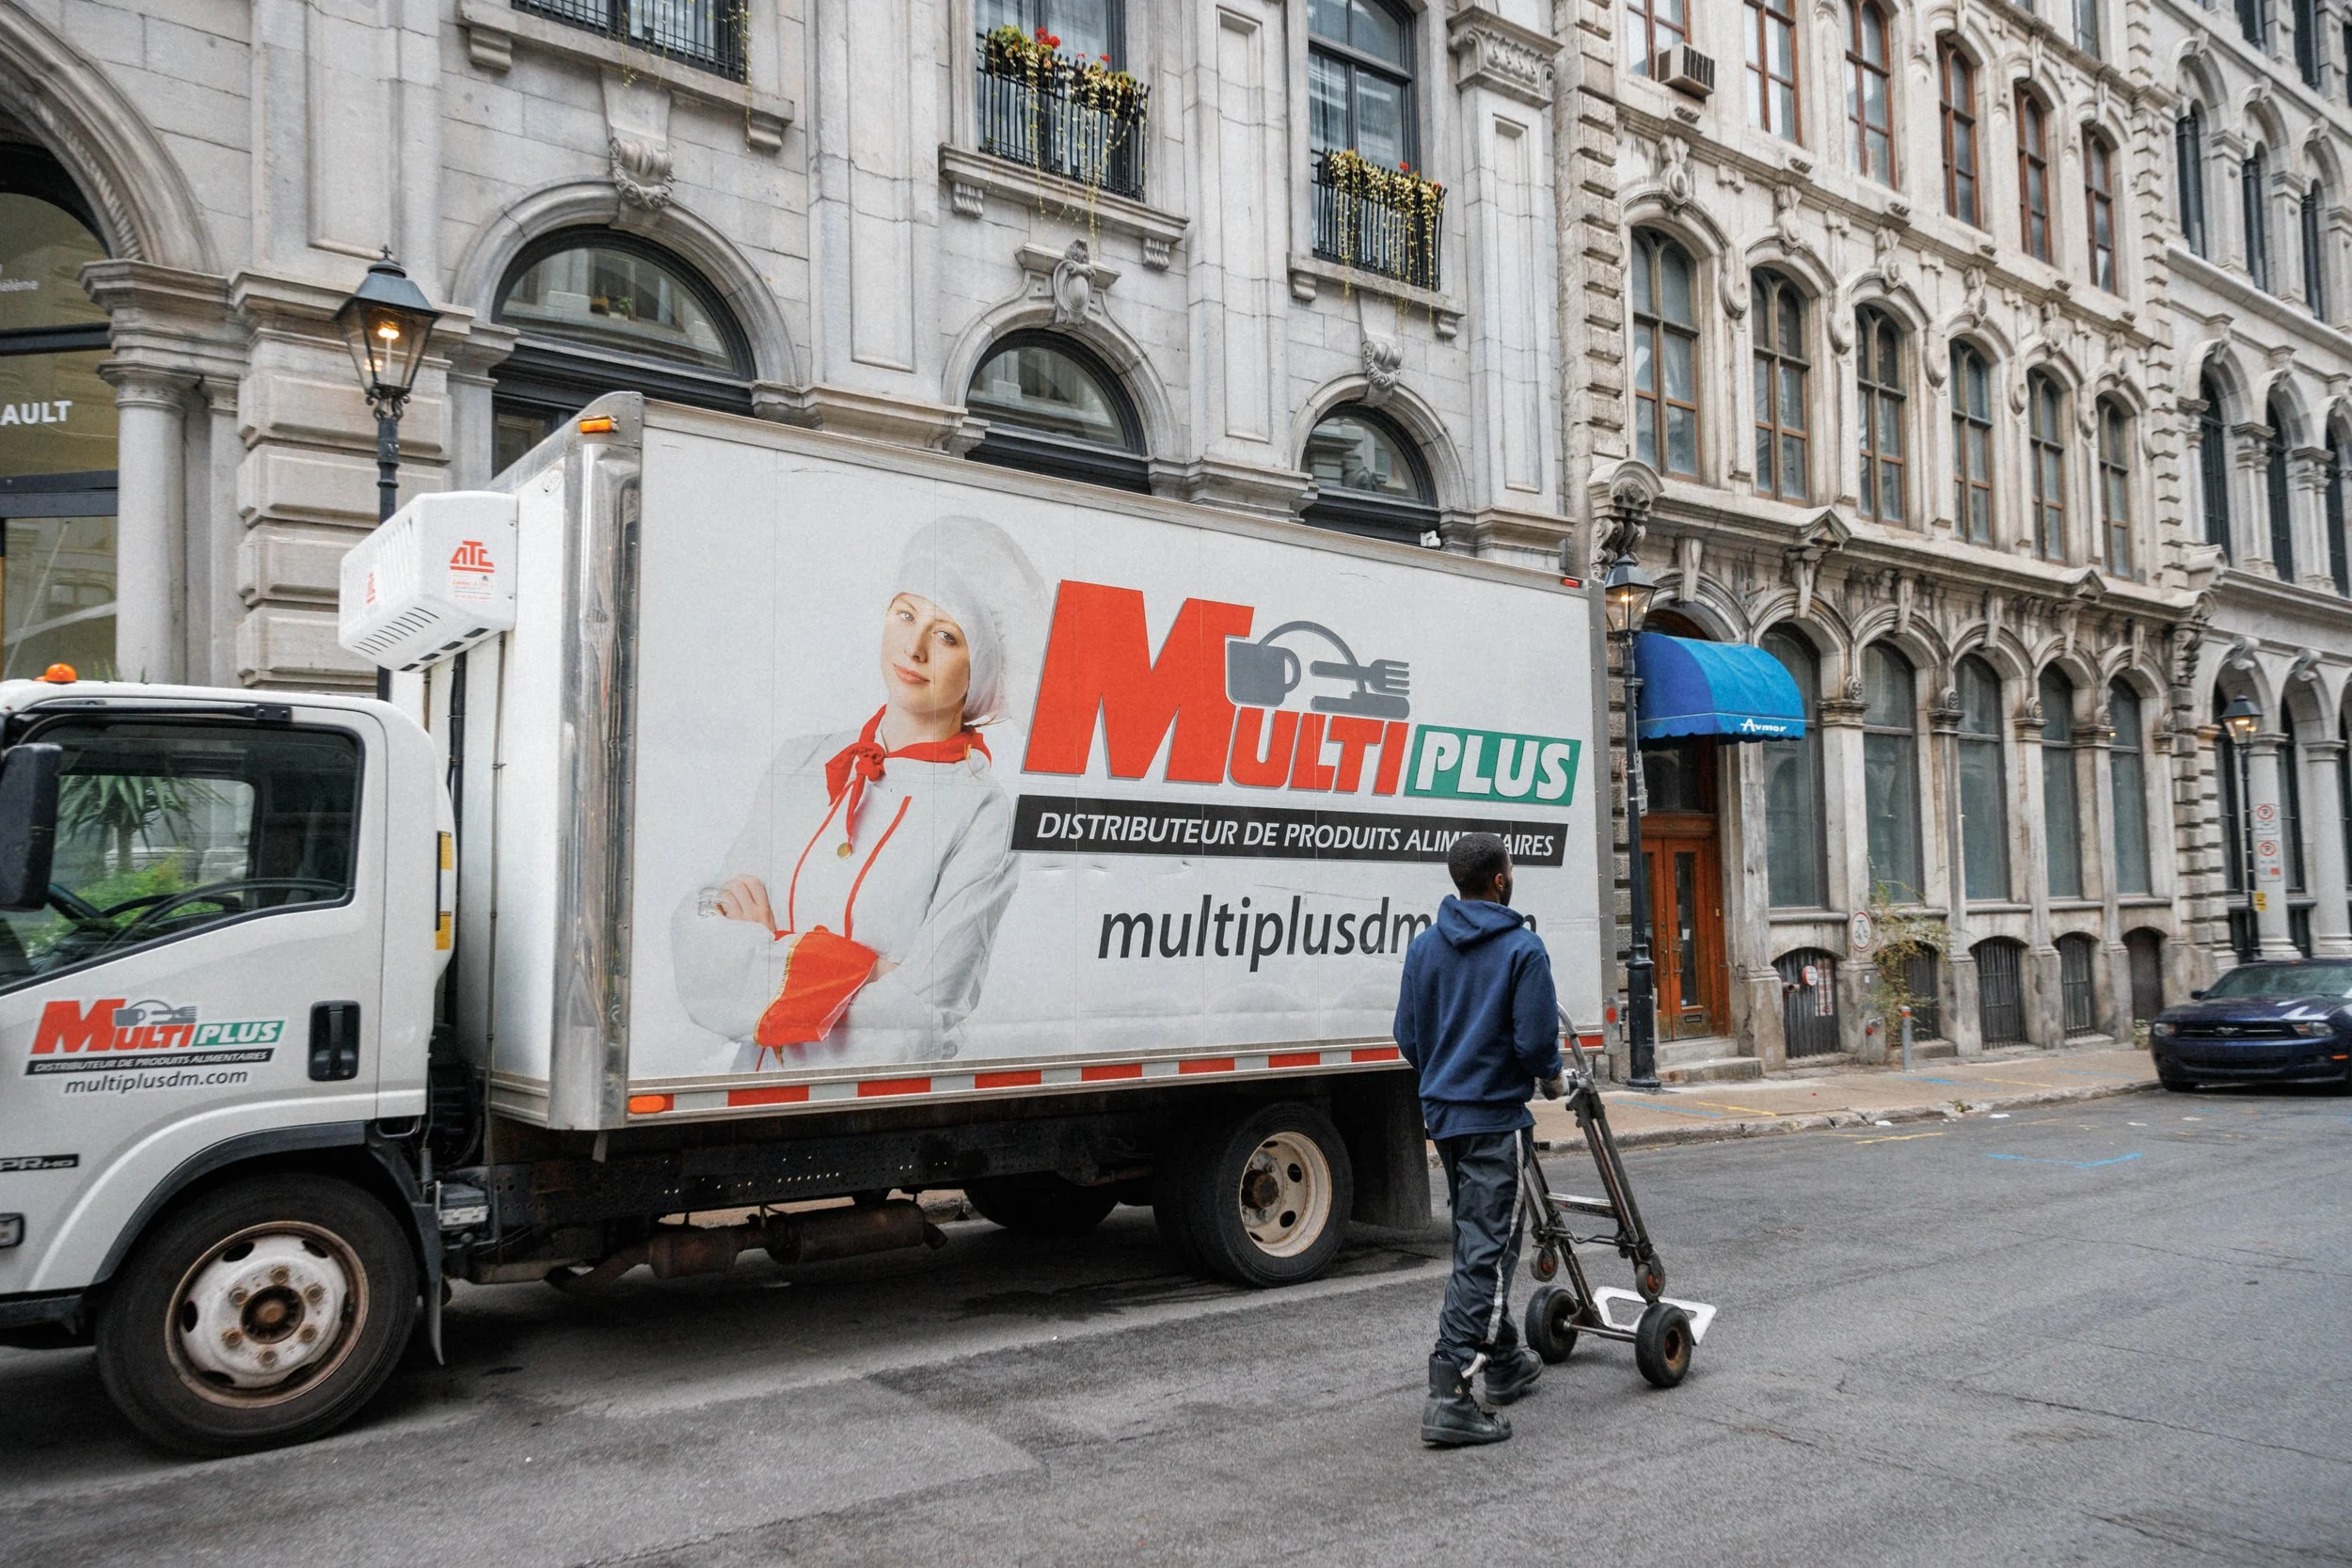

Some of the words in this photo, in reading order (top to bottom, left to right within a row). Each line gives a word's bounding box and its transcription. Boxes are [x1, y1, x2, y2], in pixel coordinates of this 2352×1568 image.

[0, 401, 72, 425] AULT
[450, 540, 495, 568] ATC
[1021, 579, 1408, 796] MULTI
[1414, 730, 1570, 800] PLUS
[1740, 718, 1787, 732] Avmor
[1036, 812, 1235, 846] DISTRIBUTEUR
[1243, 821, 1280, 847] DE
[1284, 823, 1401, 851] PRODUITS
[1404, 829, 1554, 857] ALIMAIRES
[1098, 894, 1536, 973] multiplusdm
[31, 999, 196, 1055] MULTI
[196, 1022, 279, 1045] PLUS
[34, 1059, 116, 1072] DISTRIBUTEUR
[117, 1058, 135, 1069] DE
[135, 1055, 189, 1067] PRODUITS
[190, 1051, 268, 1064] ALIMENTAIRES
[64, 1069, 247, 1094] multiplusdm.com
